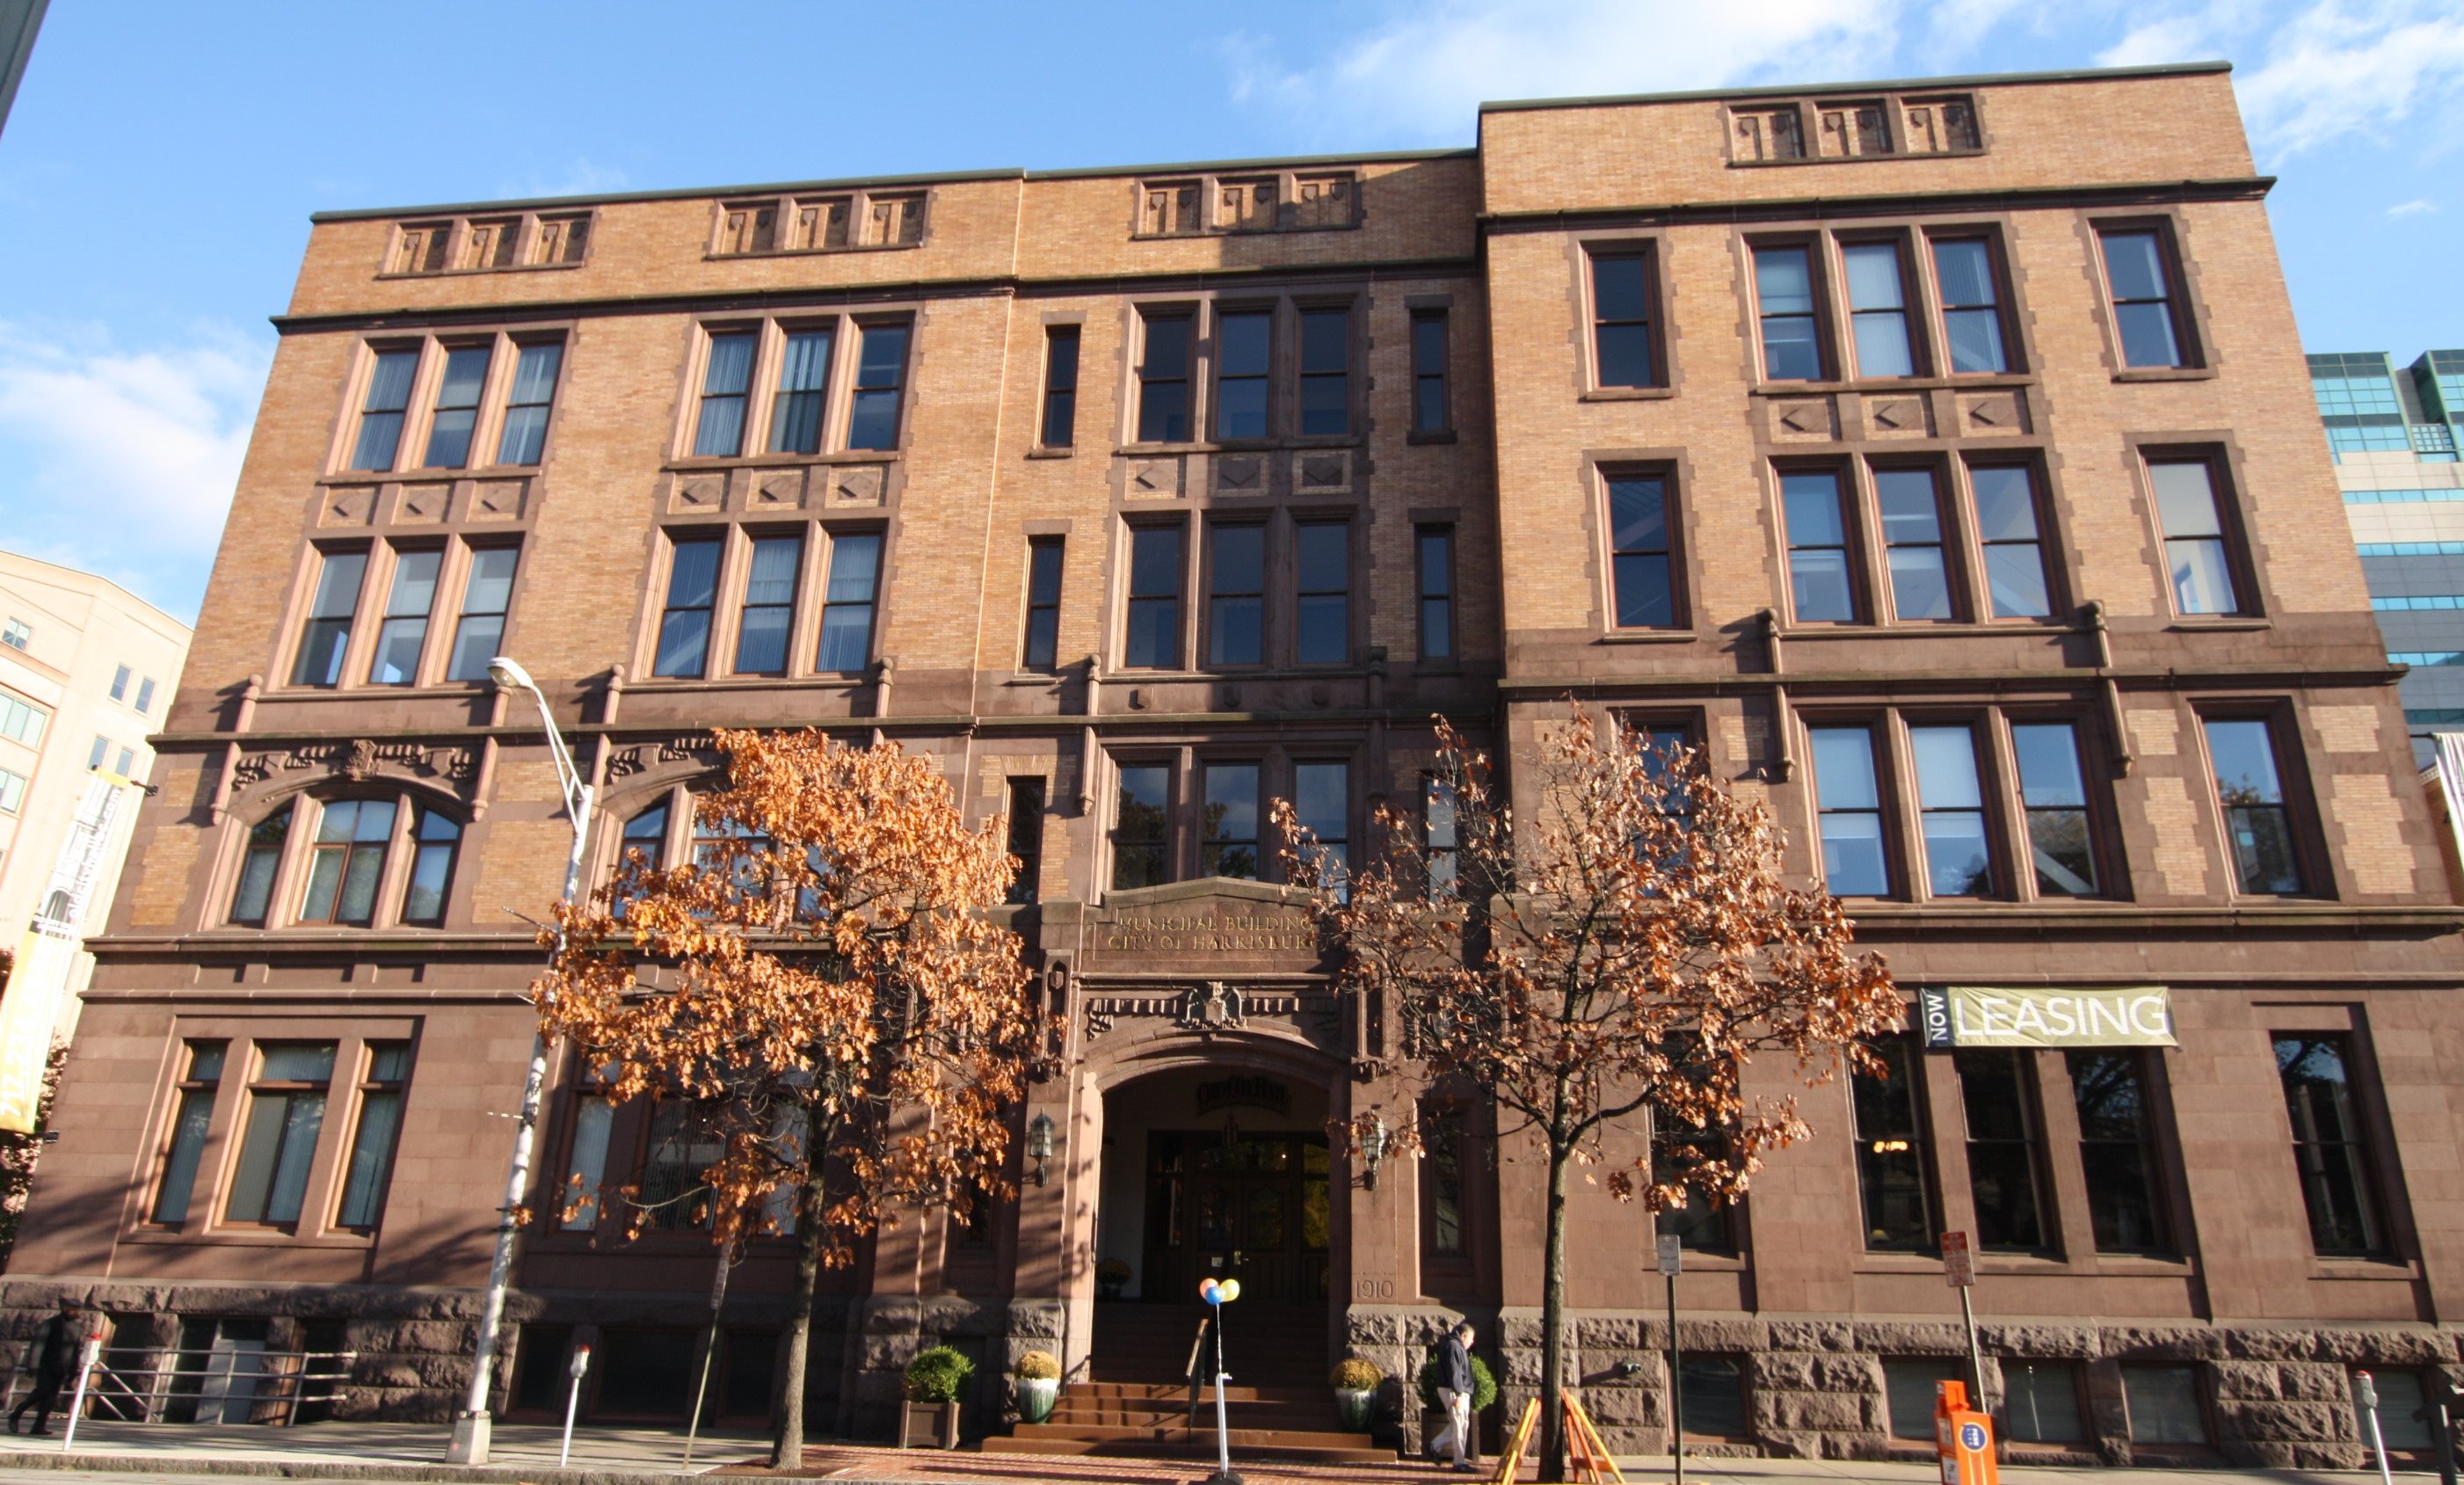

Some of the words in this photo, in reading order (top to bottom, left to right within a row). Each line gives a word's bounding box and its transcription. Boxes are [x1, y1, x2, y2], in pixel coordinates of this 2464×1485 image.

[1116, 916, 1217, 932] MUNICIPAL
[1225, 916, 1313, 931] BUILDING
[1108, 935, 1152, 950] CITY
[1159, 935, 1182, 950] OF
[1926, 994, 1949, 1041] NOW
[1954, 995, 2169, 1037] LEASING
[1355, 1279, 1393, 1299] 1910
